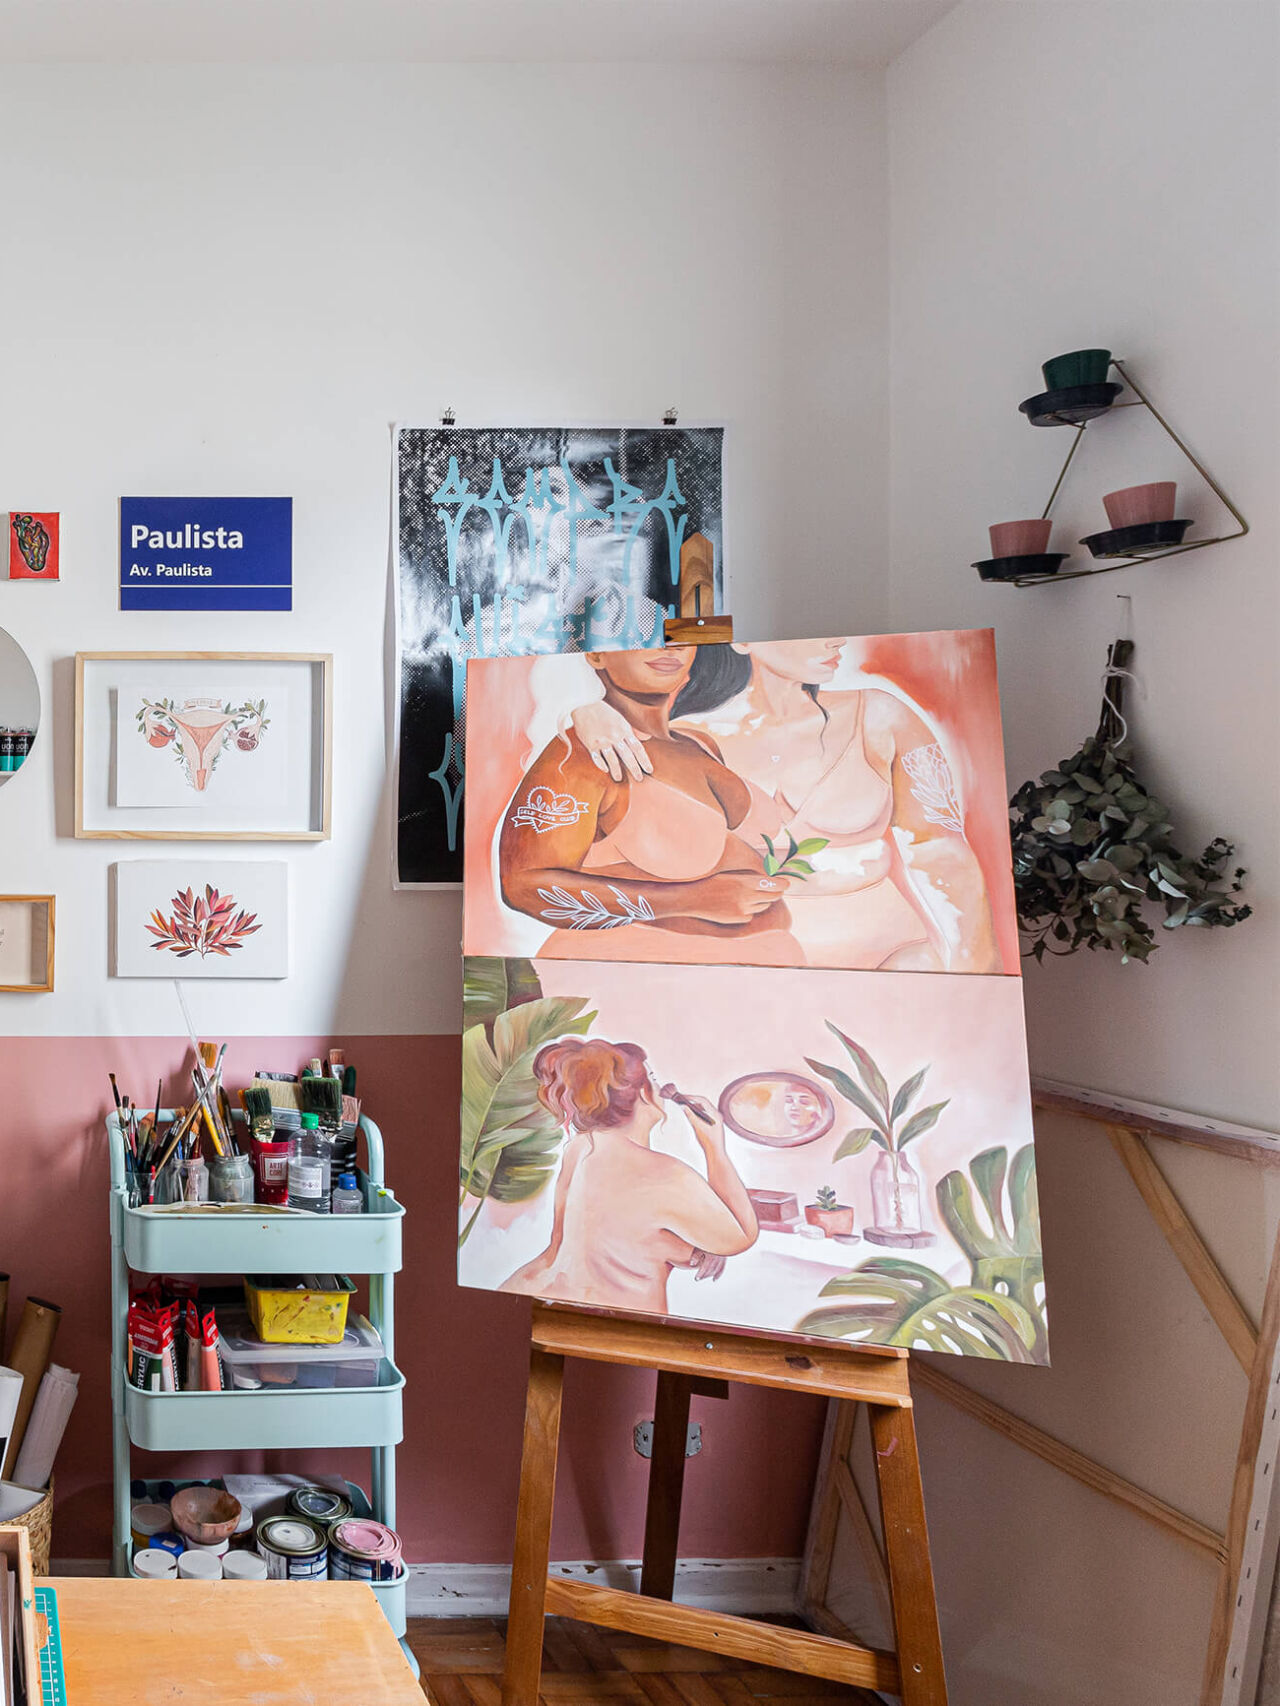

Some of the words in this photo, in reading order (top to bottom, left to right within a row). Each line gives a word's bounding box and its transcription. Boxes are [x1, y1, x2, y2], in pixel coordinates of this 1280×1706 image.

[130, 524, 244, 550] Paulista
[129, 563, 152, 577] Av.
[156, 563, 213, 577] Paulista
